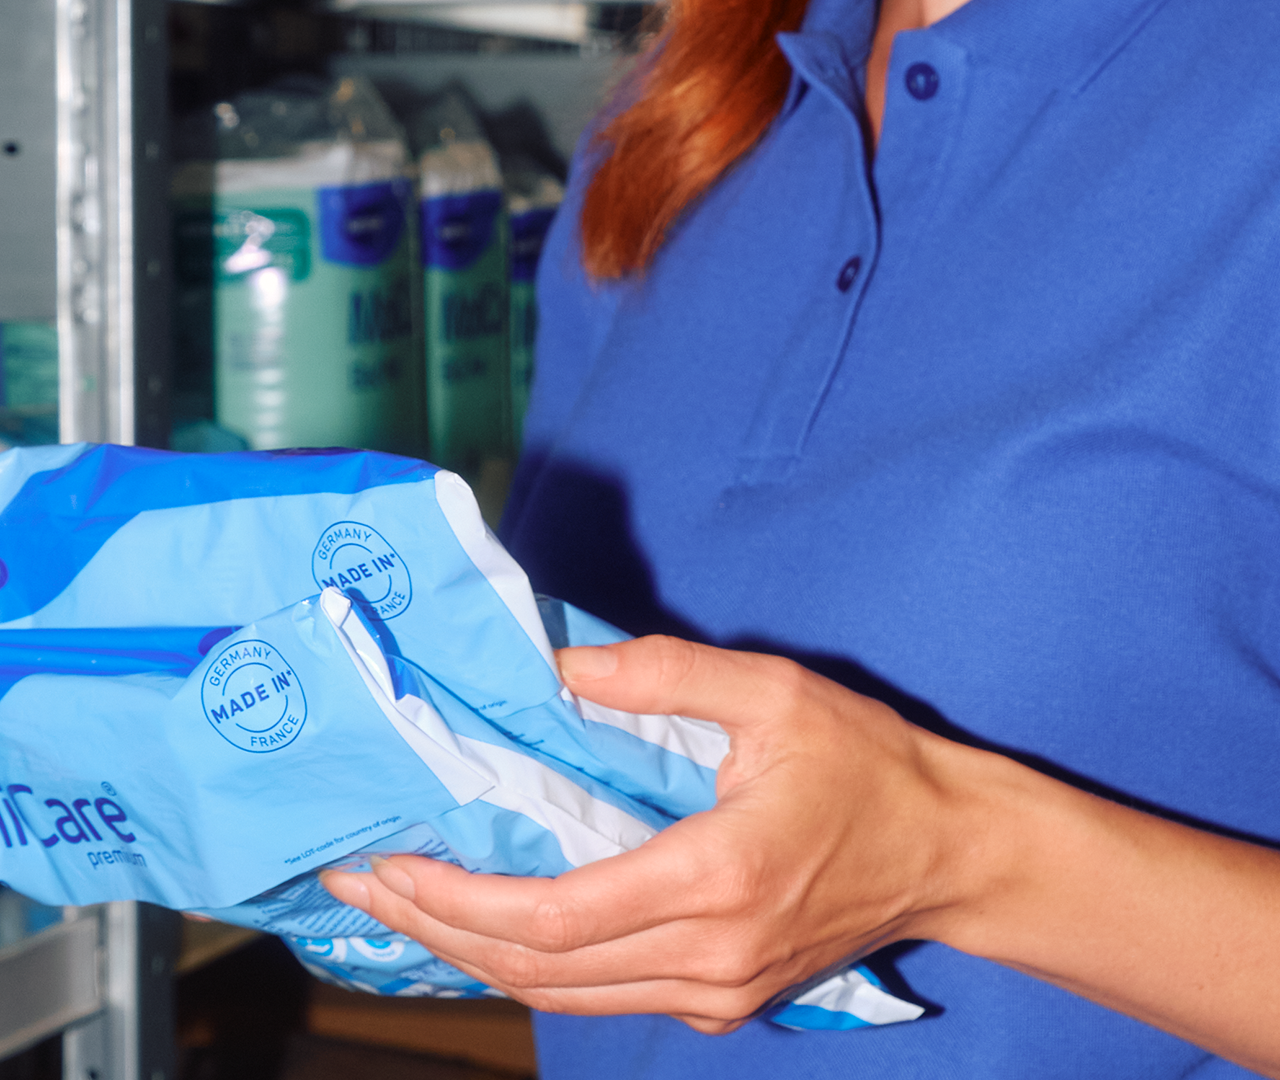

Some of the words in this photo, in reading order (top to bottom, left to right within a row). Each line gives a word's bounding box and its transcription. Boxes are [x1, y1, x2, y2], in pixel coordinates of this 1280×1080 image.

[317, 527, 372, 561] GERMANY
[208, 646, 271, 687] GERMANY
[210, 683, 270, 724] MADE
[250, 714, 300, 747] FRANCE
[301, 840, 335, 859] LOT-code
[333, 836, 345, 845] for
[345, 825, 372, 840] country
[380, 815, 402, 826] origin
[87, 849, 148, 870] premium
